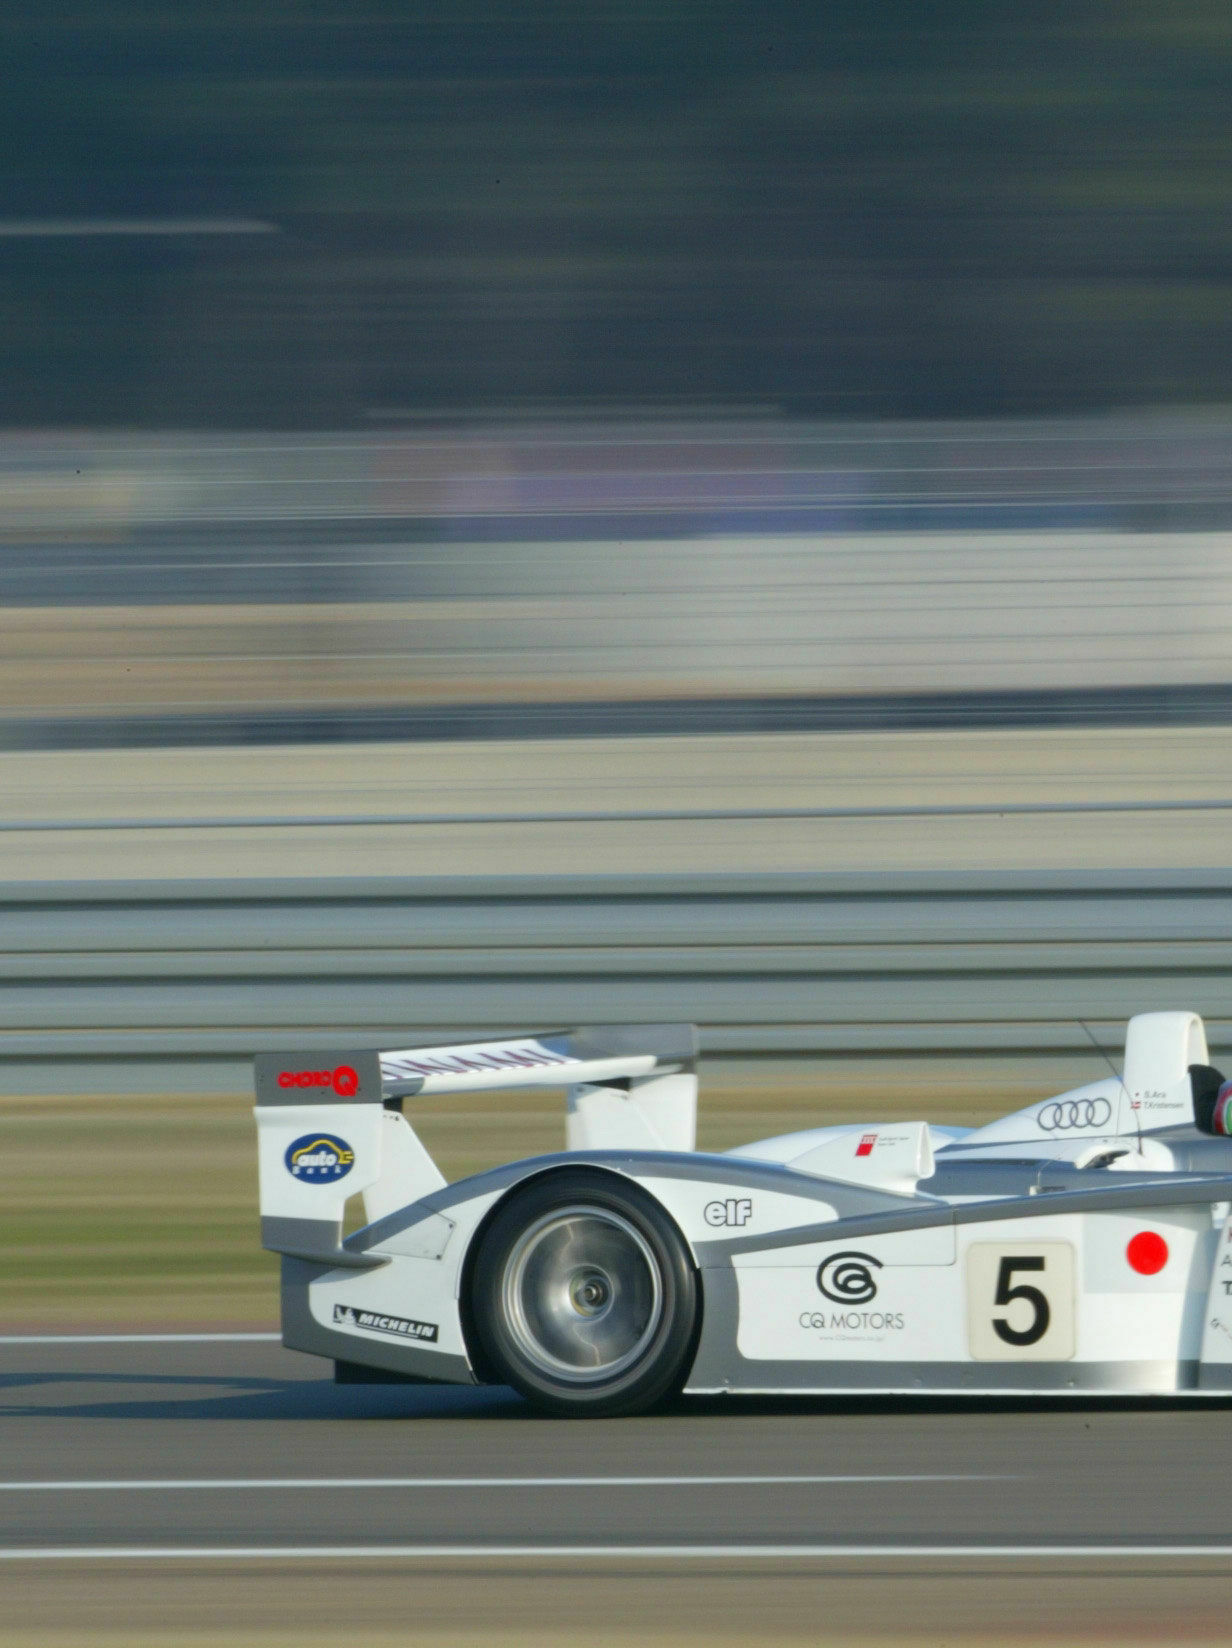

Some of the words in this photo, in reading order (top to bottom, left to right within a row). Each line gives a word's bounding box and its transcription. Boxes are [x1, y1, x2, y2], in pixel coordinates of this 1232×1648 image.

[297, 1151, 338, 1167] auto
[704, 1198, 752, 1227] elf
[991, 1256, 1050, 1346] 5
[358, 1312, 435, 1338] MICHELIN
[831, 1312, 905, 1330] MOTORS
